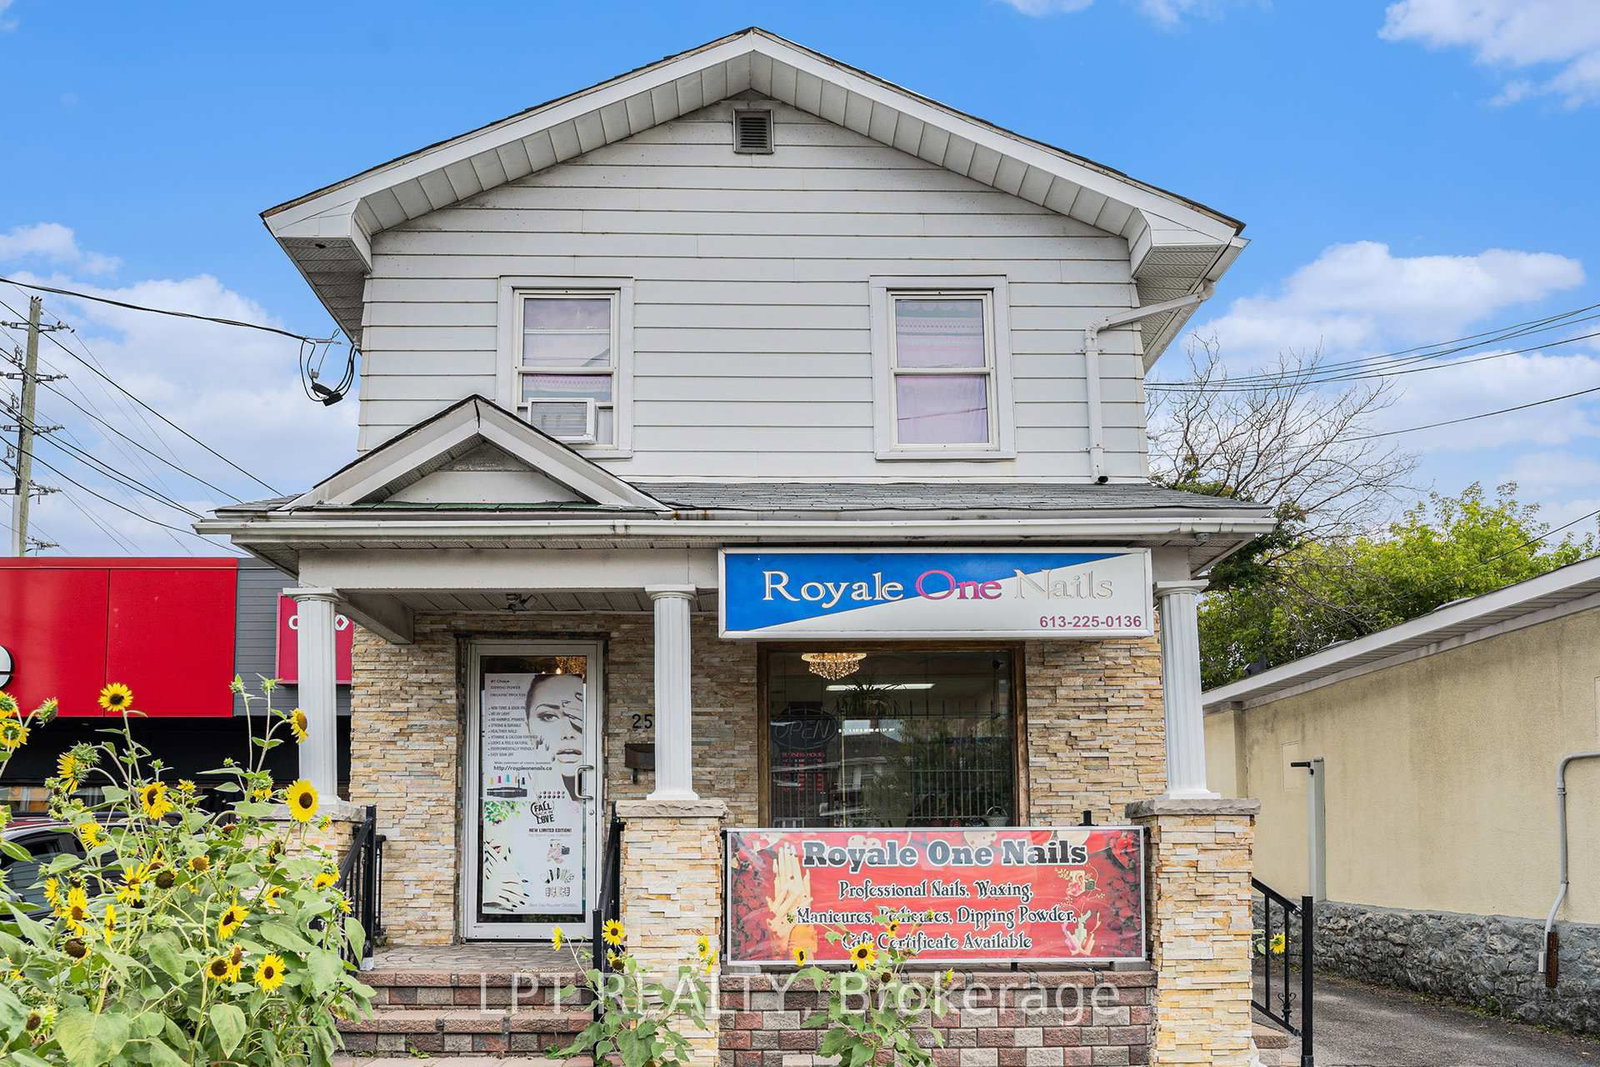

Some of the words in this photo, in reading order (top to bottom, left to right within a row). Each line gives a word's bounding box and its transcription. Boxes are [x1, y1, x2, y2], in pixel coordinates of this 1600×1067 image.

[763, 570, 904, 609] Royale
[915, 569, 1002, 601] One
[1014, 569, 1113, 600] Nails
[1039, 615, 1142, 628] 613-225-0136
[632, 713, 653, 729] 25
[775, 719, 831, 739] OPEN
[533, 800, 553, 813] FALL
[536, 813, 556, 825] LOVE
[802, 840, 919, 873] Royale
[927, 840, 994, 866] One
[1001, 839, 1088, 866] Nails
[838, 879, 927, 900] Professional
[957, 906, 1015, 930] Dipping
[877, 931, 958, 952] Certificate
[963, 931, 1033, 949] Available
